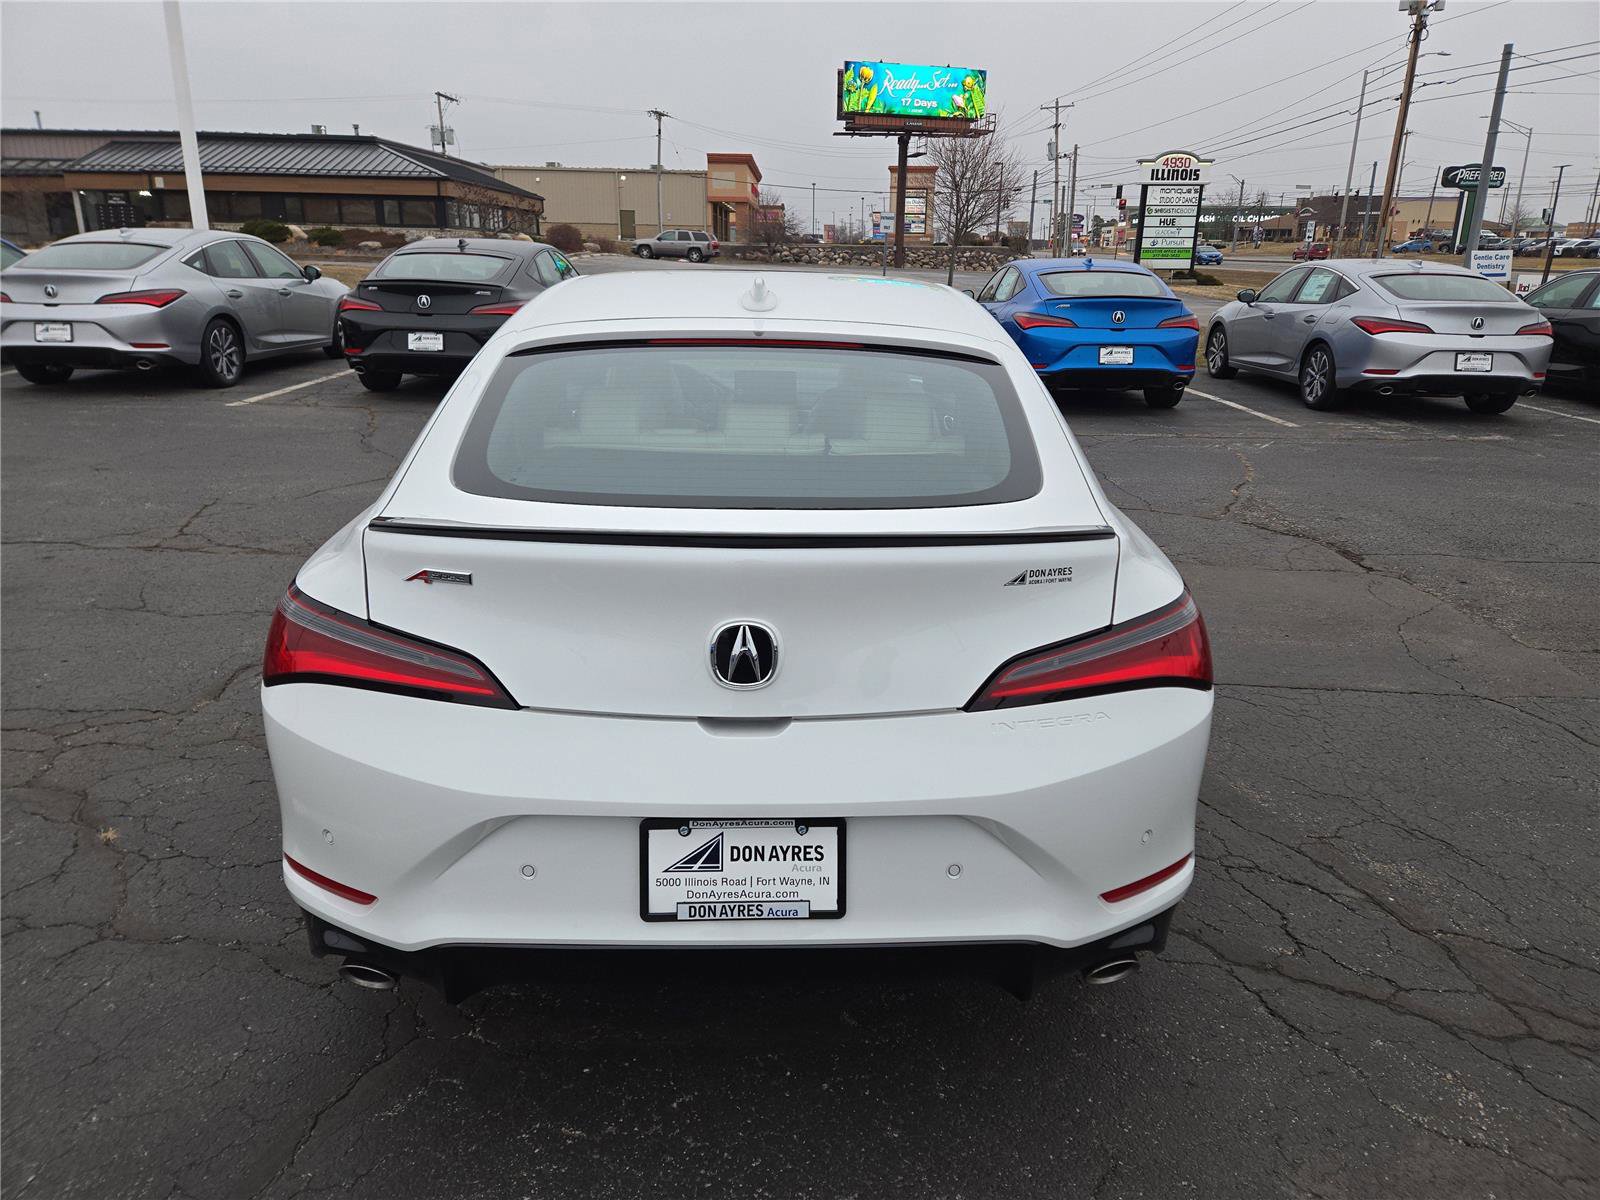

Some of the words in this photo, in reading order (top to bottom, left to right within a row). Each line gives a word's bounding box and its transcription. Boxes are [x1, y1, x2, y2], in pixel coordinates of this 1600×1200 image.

[901, 98, 912, 106] 17
[913, 99, 938, 109] Days
[1162, 157, 1192, 169] 4930
[1150, 168, 1200, 181] ILLINOIS
[1456, 169, 1504, 183] PREFRED
[1159, 217, 1177, 226] HUE
[1198, 214, 1216, 223] ASH
[1476, 263, 1506, 271] Dentistry
[1028, 569, 1047, 578] DON
[1047, 566, 1073, 577] AYRES
[991, 711, 1112, 731] INTEGRA
[691, 820, 794, 828] DonAyresAcura.com
[730, 845, 765, 863] DON
[768, 844, 825, 863] AYRES
[791, 864, 823, 873] Acura
[655, 877, 682, 887] 5000
[684, 876, 718, 887] Illinois
[721, 876, 747, 886] Road
[756, 876, 777, 886] Fort
[779, 876, 816, 888] Wayne,
[819, 876, 830, 886] IN
[686, 889, 799, 901] DonAyresAcura.com
[688, 904, 717, 918] DON
[719, 904, 764, 918] AYRES
[767, 906, 799, 918] Acura
